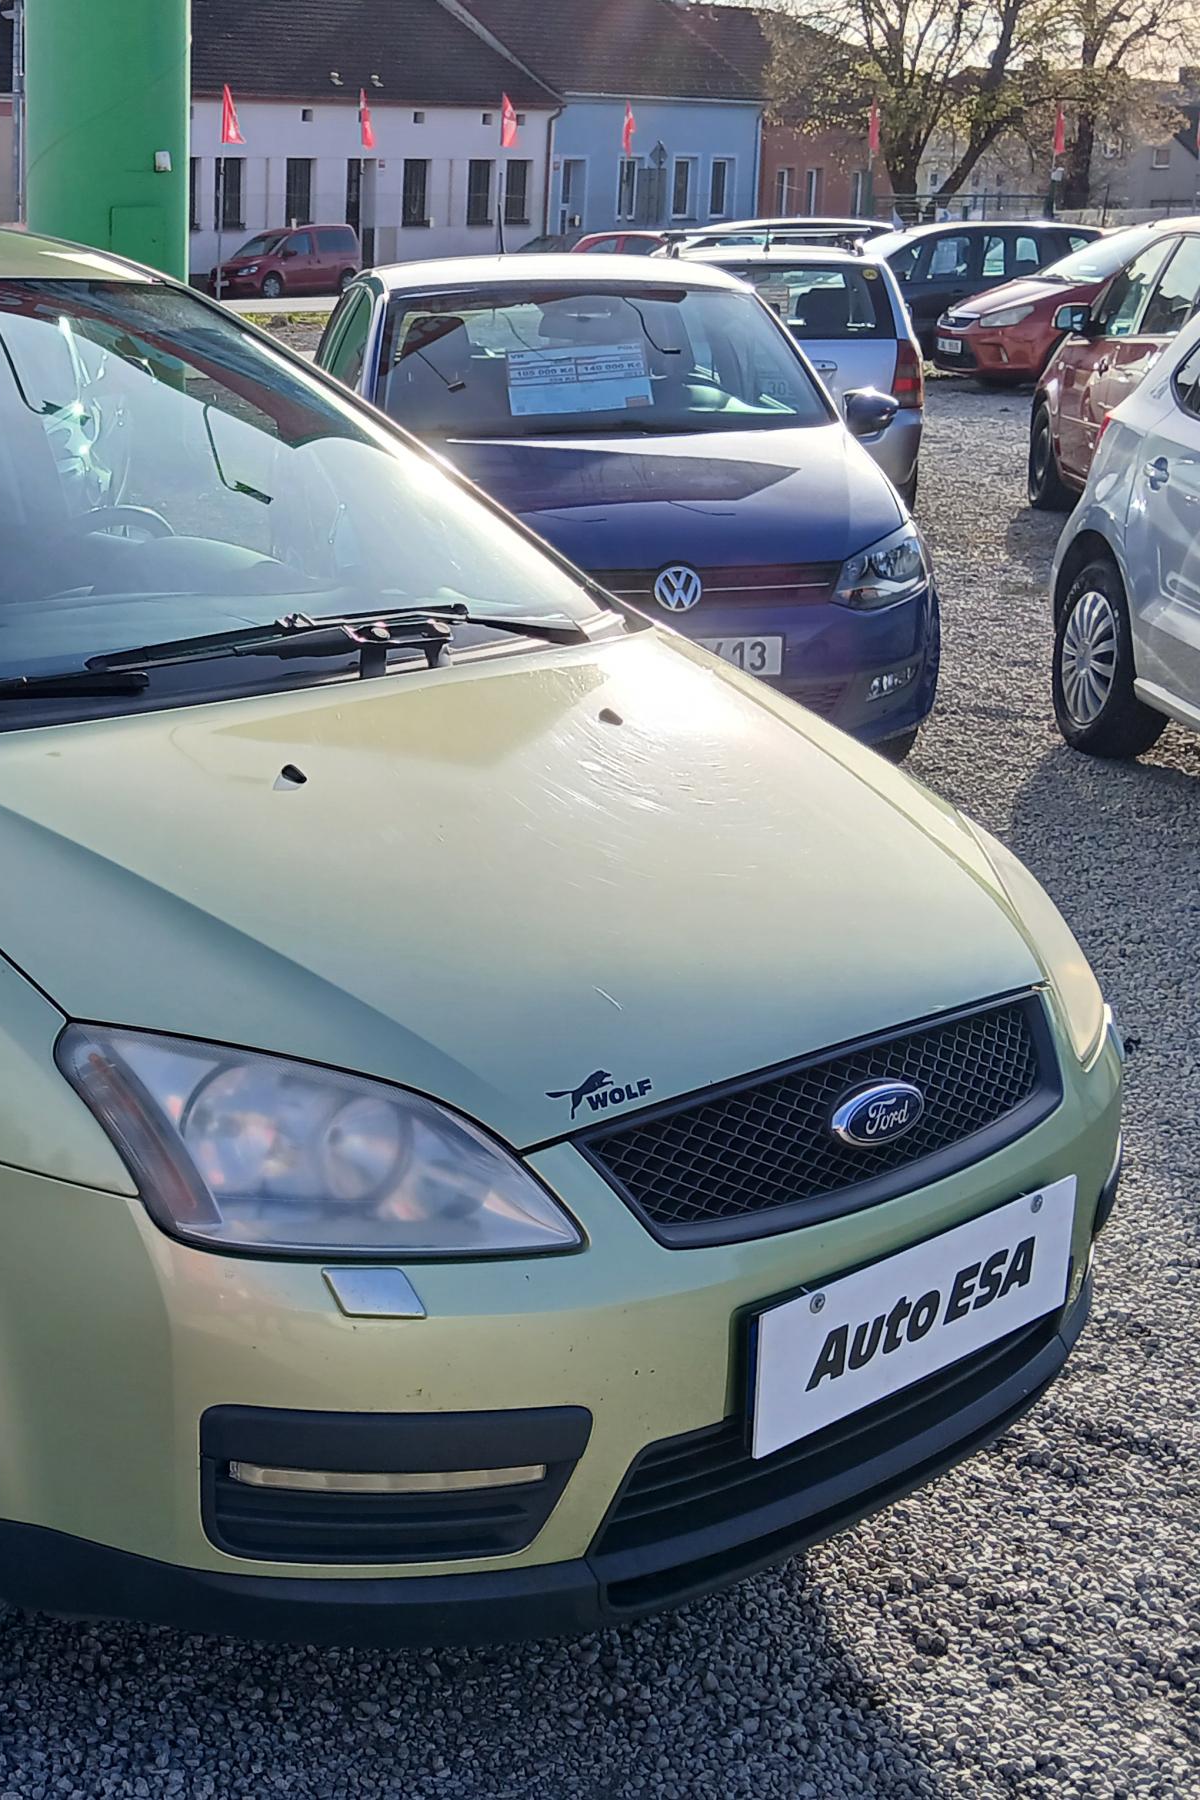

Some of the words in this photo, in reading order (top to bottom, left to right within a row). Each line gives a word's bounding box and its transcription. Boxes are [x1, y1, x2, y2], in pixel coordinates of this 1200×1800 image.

[586, 1079, 652, 1111] WOLF
[865, 1097, 910, 1135] Ford
[805, 1290, 941, 1393] Auto
[942, 1236, 1036, 1326] ESA
